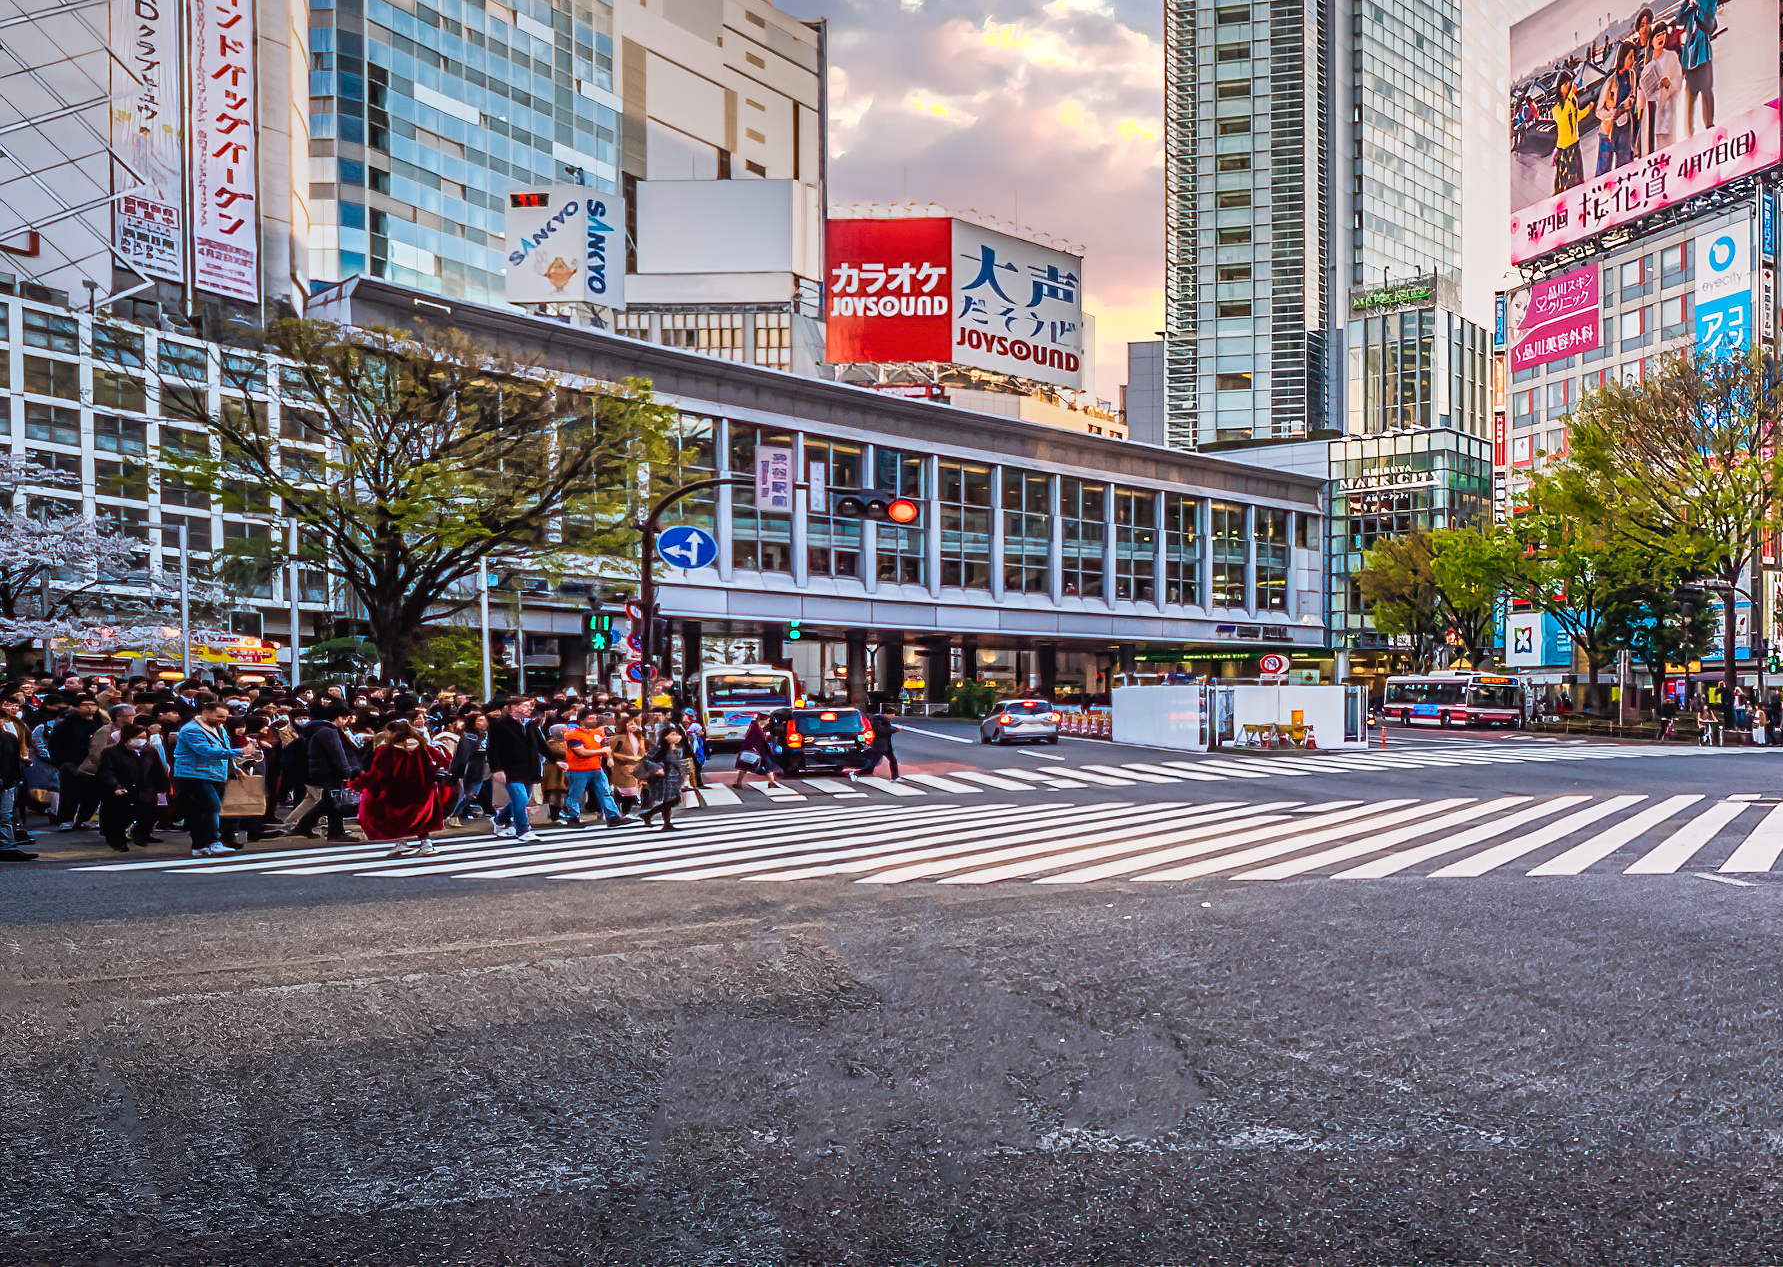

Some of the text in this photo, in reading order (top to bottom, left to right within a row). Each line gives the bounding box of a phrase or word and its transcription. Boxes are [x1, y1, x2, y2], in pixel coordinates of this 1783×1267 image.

[1527, 130, 1757, 241] 第79回 桜花賞 4月7日(日)
[509, 201, 579, 266] SANKYO
[587, 199, 614, 294] SANKYO
[831, 262, 947, 294] カラオケ
[960, 244, 1079, 308] 大声
[830, 295, 949, 317] JOYSOUND
[956, 326, 1079, 372] JOYSOUND
[1339, 471, 1440, 491] MARK CITY
